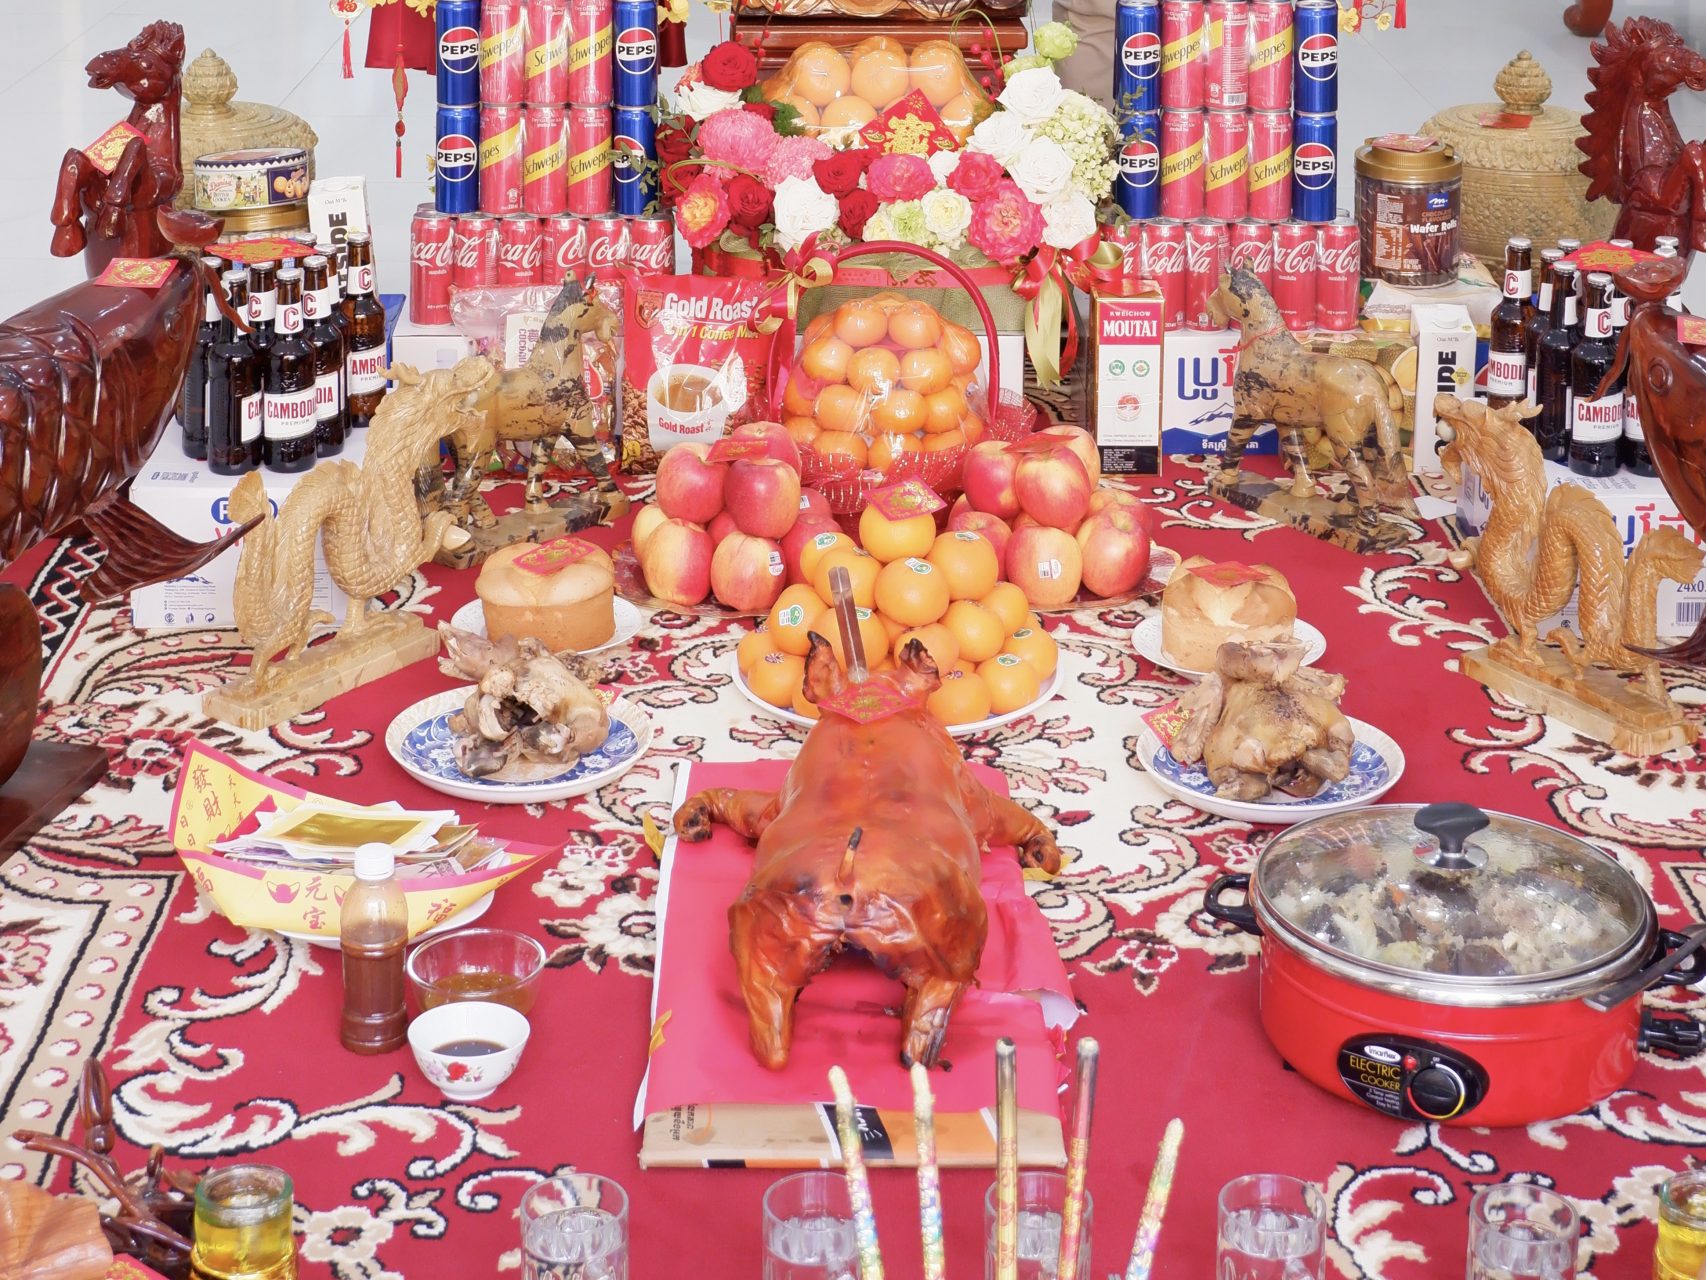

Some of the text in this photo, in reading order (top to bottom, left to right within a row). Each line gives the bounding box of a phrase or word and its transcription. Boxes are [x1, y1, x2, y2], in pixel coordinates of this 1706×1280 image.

[618, 43, 655, 56] PEPSI
[438, 151, 475, 163] PEPSI
[1121, 157, 1158, 169] PEPSI
[1296, 159, 1333, 171] PEPSI
[1410, 223, 1439, 234] Wafer
[664, 293, 708, 319] Gold
[284, 307, 299, 331] C
[700, 326, 734, 341] Coffee
[1103, 320, 1157, 337] MOUTAI
[268, 397, 317, 420] CAMBODI
[1578, 403, 1622, 423] CAMBOD
[658, 418, 704, 434] Gold Roast
[1350, 1055, 1400, 1080] ELECTRIC
[1361, 1074, 1400, 1091] COOKER
